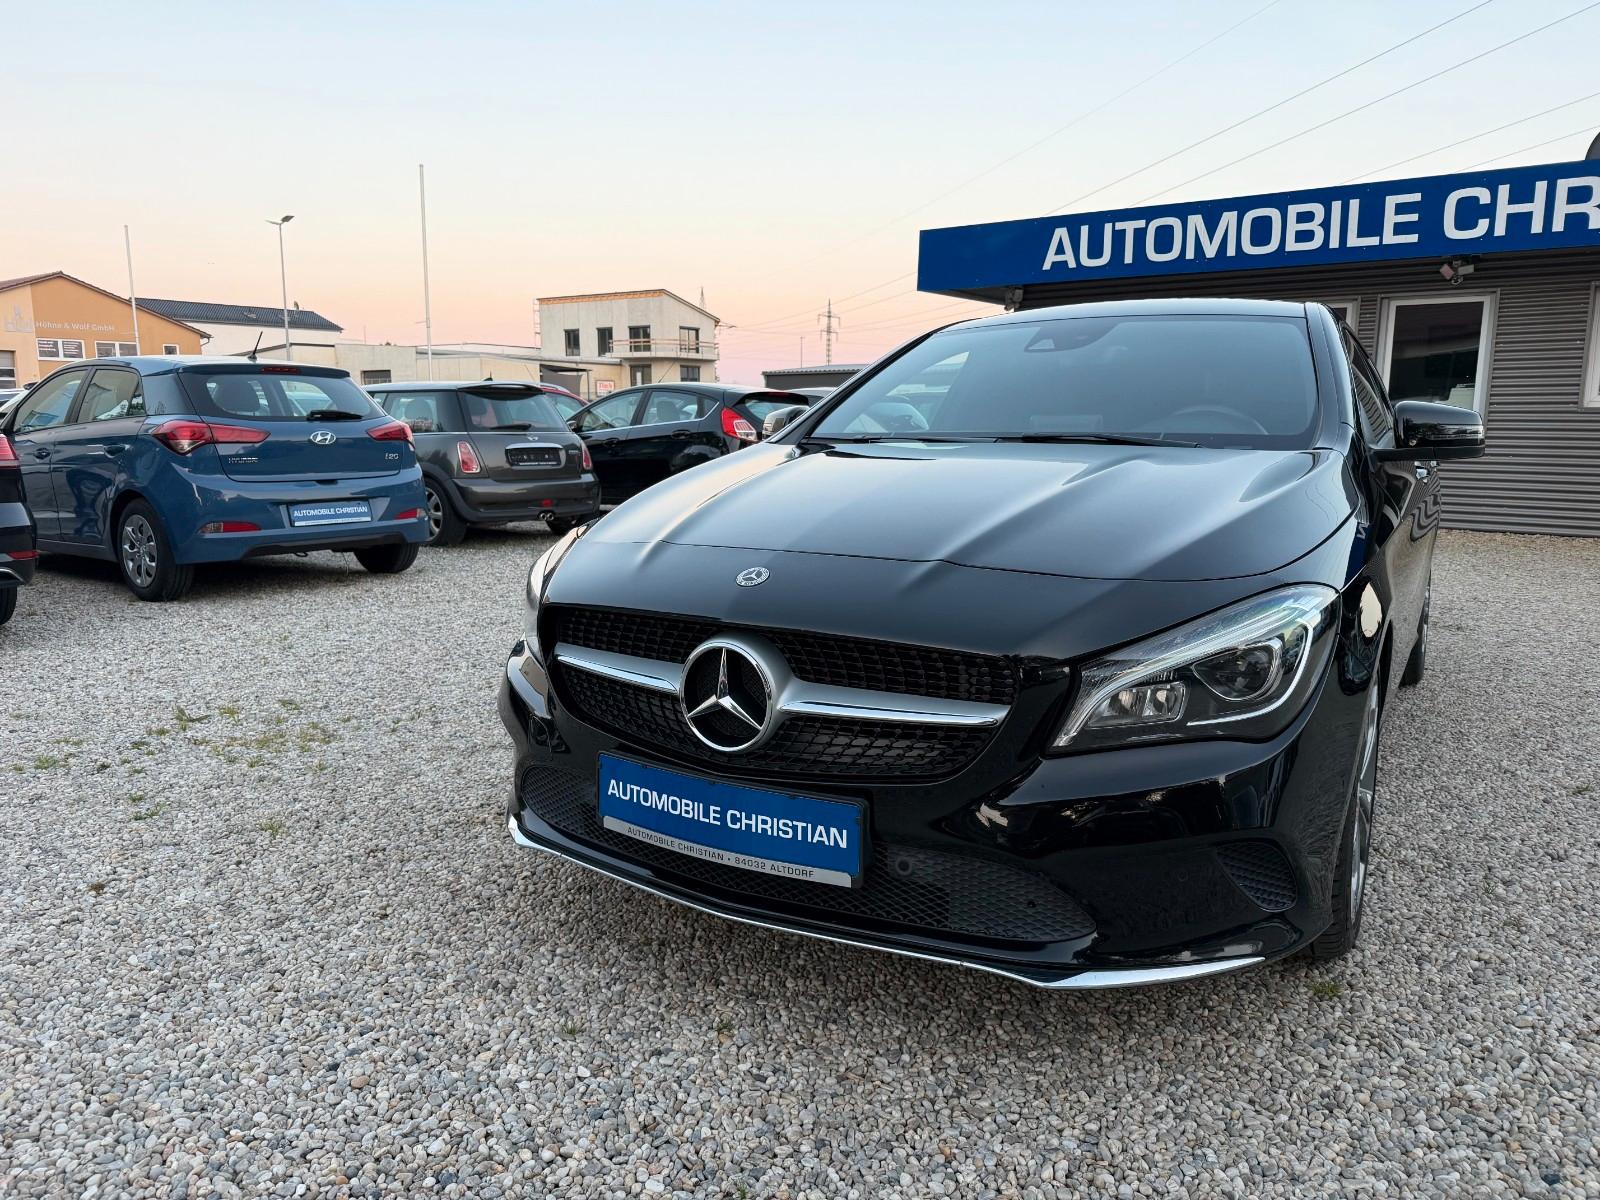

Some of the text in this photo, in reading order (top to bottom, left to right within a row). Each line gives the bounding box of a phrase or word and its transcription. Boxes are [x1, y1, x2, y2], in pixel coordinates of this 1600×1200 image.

[1042, 192, 1422, 271] AUTOMOBILE
[71, 322, 91, 330] Wolf
[91, 323, 115, 332] GmbH
[293, 505, 368, 517] AUTOMOBILE CHRISTIAN
[607, 778, 848, 849] AUTOMOBILE CHRISTIAN
[627, 826, 815, 878] AUTOMOBILE CHRISTIAN 84032 ALTDORF
